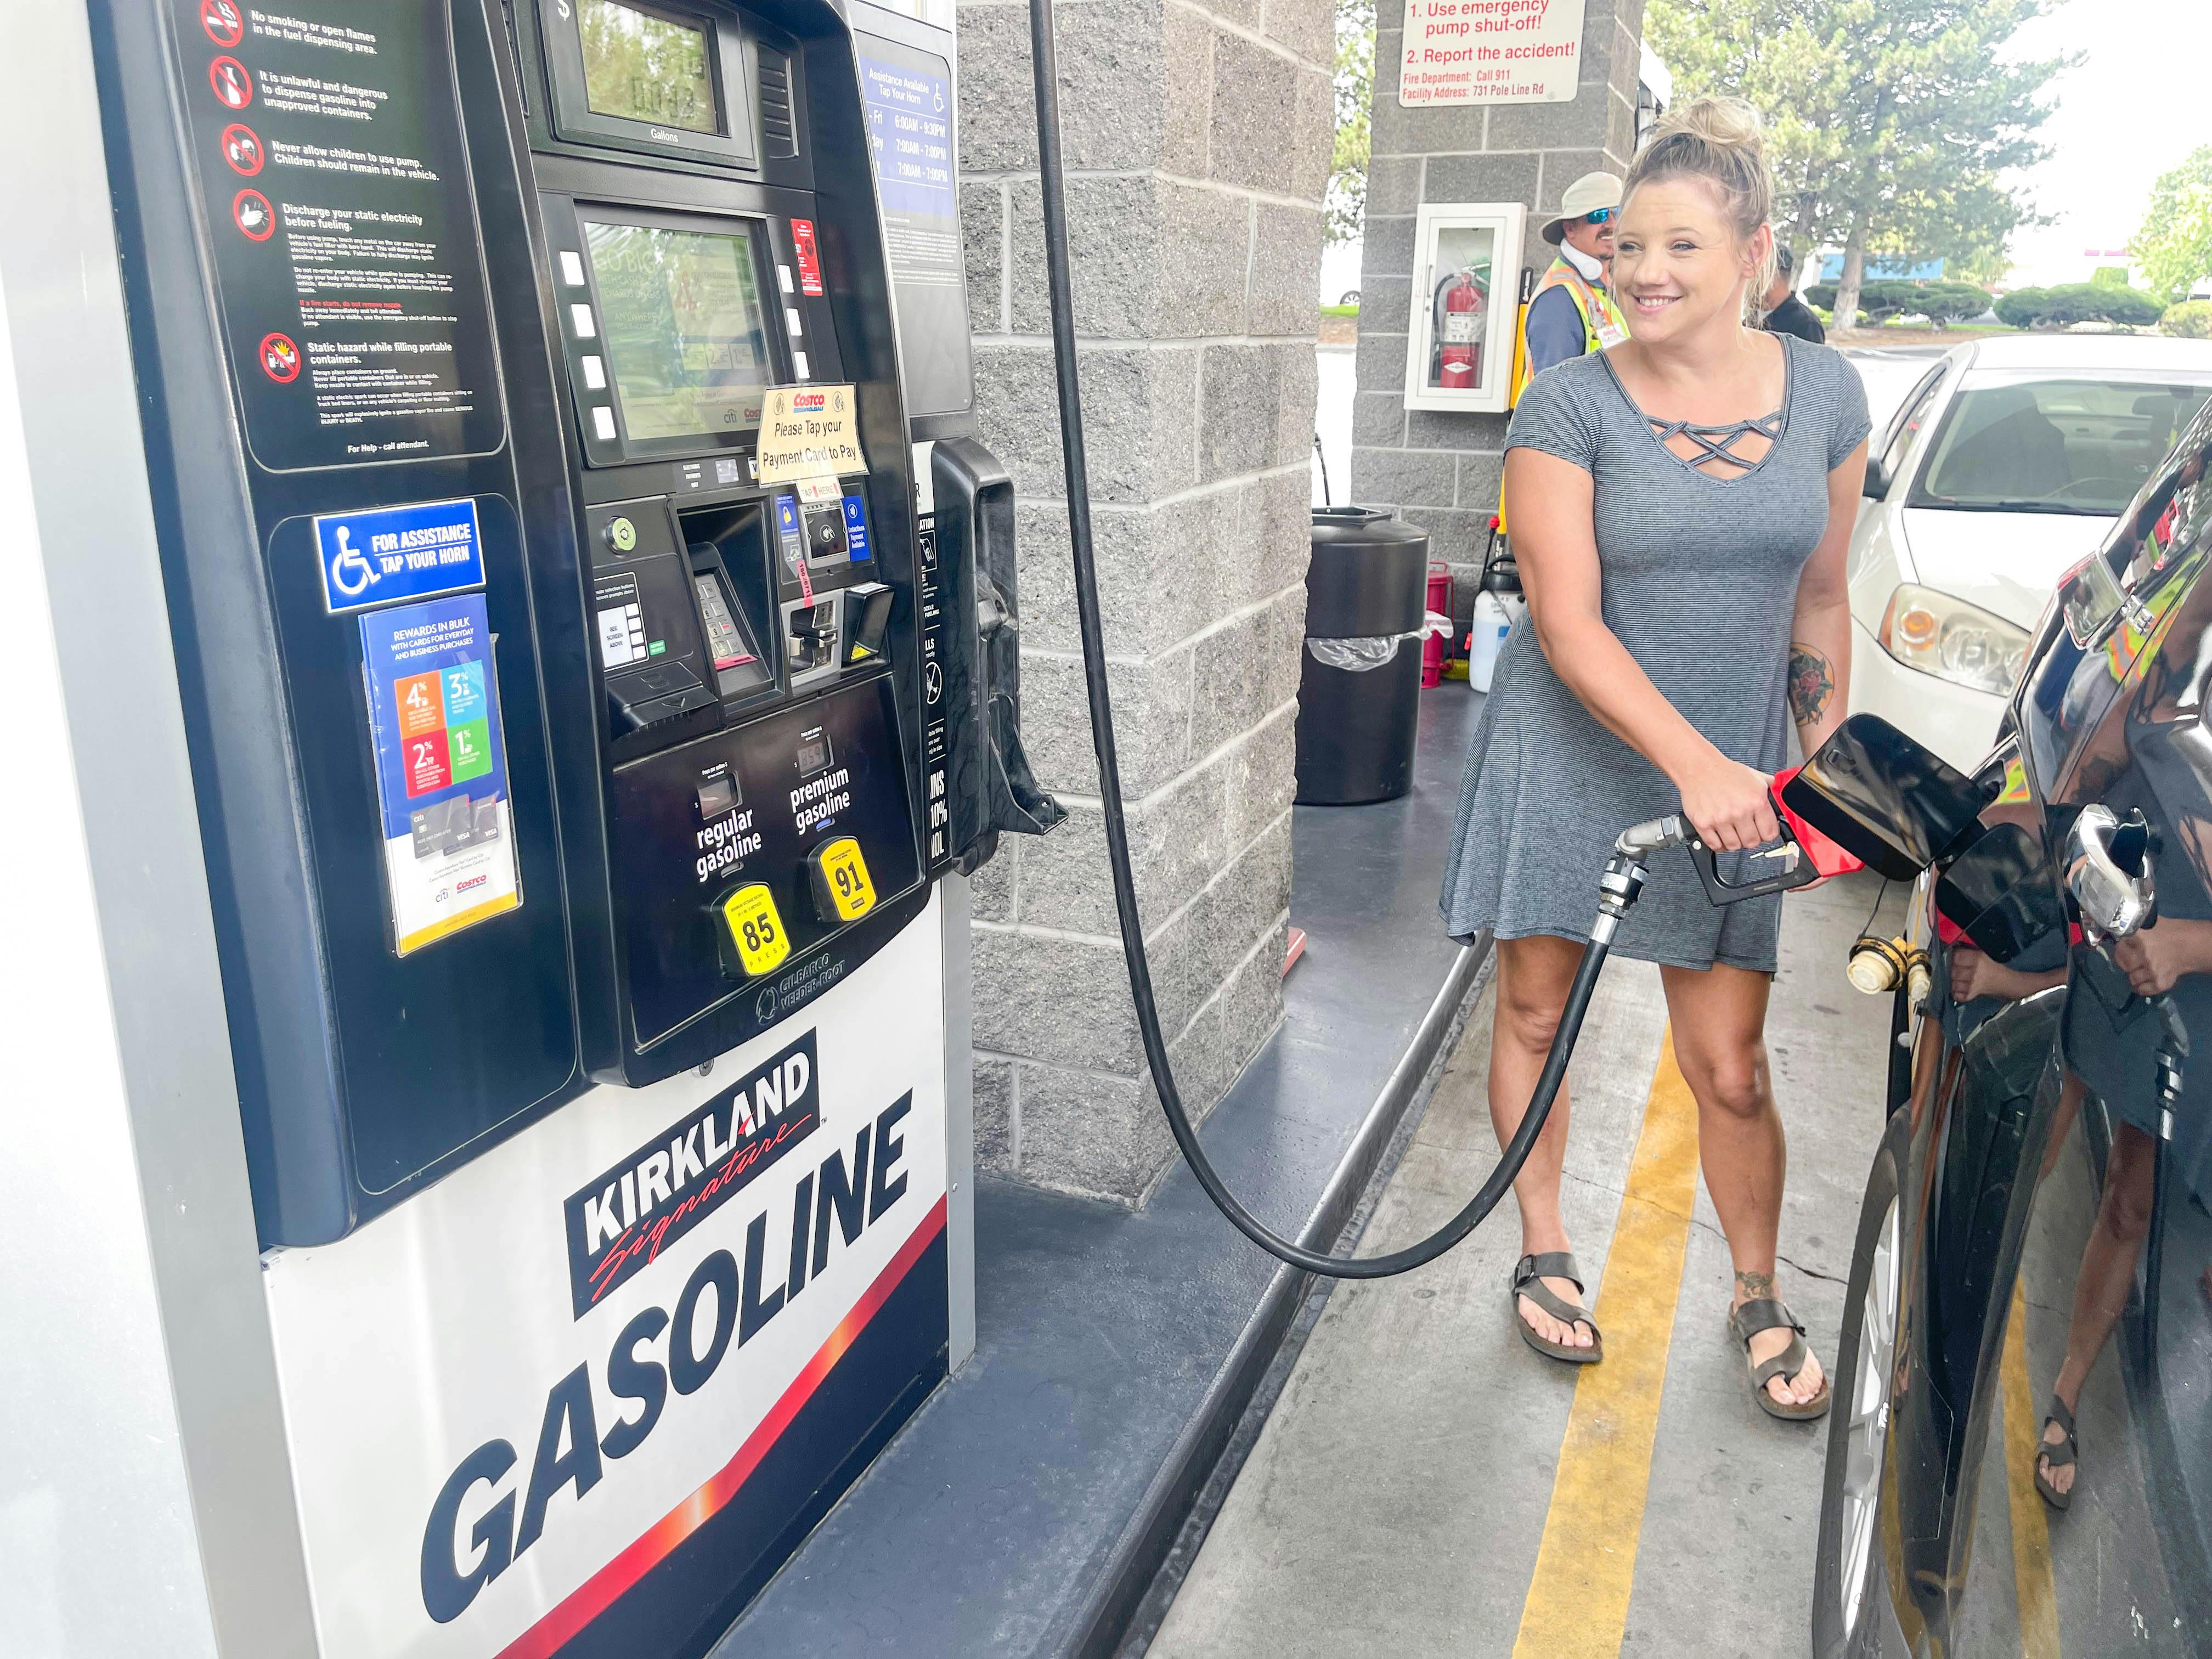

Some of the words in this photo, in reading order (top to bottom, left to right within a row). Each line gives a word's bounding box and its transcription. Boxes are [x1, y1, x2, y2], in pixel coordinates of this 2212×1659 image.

[1410, 4, 1421, 17] 1.
[1427, 2, 1456, 16] Use
[1462, 0, 1549, 16] emergency
[251, 10, 266, 22] No
[268, 15, 307, 31] smoking
[322, 25, 344, 37] open
[346, 28, 376, 42] flames
[1426, 22, 1469, 38] pump
[1475, 15, 1542, 33] shut-off!
[253, 24, 262, 33] in
[265, 25, 281, 37] the
[283, 29, 302, 41] fuel
[304, 33, 353, 52] dispensing
[355, 44, 377, 55] area.
[1407, 50, 1419, 63] 2.
[1424, 48, 1472, 65] Report
[1477, 46, 1500, 60] the
[1505, 42, 1575, 59] accident!
[259, 70, 268, 81] It
[270, 72, 278, 82] is
[281, 76, 320, 89] unlawful
[323, 83, 340, 92] and
[342, 84, 388, 100] dangerous
[869, 68, 902, 87] Assistance
[904, 78, 929, 94] Available
[1404, 72, 1419, 84] Fire
[1422, 71, 1471, 85] Department:
[1477, 70, 1493, 81] Call
[1496, 70, 1510, 81] 911
[262, 83, 273, 94] to
[275, 86, 317, 100] dispense
[319, 94, 357, 106] gasoline
[359, 100, 376, 109] into
[879, 84, 890, 98] Tap
[891, 87, 905, 100] Your
[906, 92, 921, 104] Horn
[1403, 87, 1431, 100] Facility
[1434, 87, 1469, 99] Address:
[1473, 85, 1487, 97] 731
[1491, 84, 1509, 96] Pole
[1511, 84, 1529, 95] Line
[1533, 83, 1544, 94] Rd
[264, 98, 320, 112] unapproved
[323, 106, 373, 120] containers.
[651, 128, 679, 143] Gallons
[874, 109, 883, 124] Fri
[895, 115, 918, 132] 6:00AM
[924, 121, 945, 138] 9:30PM
[272, 140, 301, 154] Never
[303, 145, 328, 156] allow
[329, 148, 366, 161] children
[368, 154, 377, 162] to
[379, 156, 394, 164] use
[396, 157, 422, 168] pump.
[896, 139, 919, 155] 7:00AM
[925, 145, 946, 160] 7:00PM
[274, 154, 314, 167] Children
[318, 158, 348, 170] should
[350, 164, 380, 174] remain
[382, 166, 391, 176] in
[393, 167, 406, 177] the
[408, 170, 439, 180] vehicle.
[898, 162, 921, 178] 7:00AM
[926, 167, 948, 182] 7:00PM
[282, 203, 330, 218] Discharge
[332, 209, 352, 219] your
[354, 211, 379, 221] static
[381, 212, 422, 226] electricity
[285, 216, 316, 228] before
[318, 219, 352, 232] fueling.
[307, 342, 335, 352] Static
[337, 342, 368, 352] hazard
[370, 342, 393, 351] while
[394, 342, 417, 353] filling
[420, 342, 452, 353] portable
[311, 355, 362, 364] containers.
[794, 393, 825, 407] COSTCO
[724, 409, 737, 424] citi
[744, 408, 761, 418] COST
[775, 422, 802, 437] Please
[805, 420, 820, 437] Tap
[823, 421, 842, 437] your
[348, 445, 360, 453] For
[361, 444, 377, 453] Help
[397, 440, 429, 449] attendant.
[763, 449, 804, 469] Payment
[805, 447, 827, 461] Card
[829, 447, 838, 459] to
[839, 445, 856, 460] Pay
[801, 489, 812, 497] TAP
[819, 486, 834, 494] HERE
[919, 517, 934, 531] ATION
[372, 533, 398, 552] FOR
[400, 523, 471, 548] ASSISTANCE
[380, 555, 404, 574] TAP
[406, 549, 437, 569] YOUR
[438, 545, 470, 565] HORN
[391, 642, 408, 651] WITH
[409, 637, 431, 647] CARDS
[431, 635, 444, 643] FOR
[444, 628, 474, 640] EVERYDAY
[393, 623, 437, 641] REWARDS
[438, 622, 448, 631] IN
[449, 617, 470, 630] BULK
[395, 651, 409, 660] AND
[410, 645, 439, 657] BUSINESS
[439, 637, 473, 651] PURCHASES
[407, 681, 426, 708] 4%
[449, 672, 469, 698] 3%
[455, 729, 471, 754] 1%
[413, 741, 433, 769] 2%
[790, 769, 849, 813] premium
[414, 812, 424, 822] citi
[796, 791, 850, 835] gasoline
[930, 799, 947, 829] 10%
[457, 832, 470, 840] VISA
[484, 828, 496, 837] VISA
[697, 809, 752, 849] regular
[697, 832, 761, 882] gasoline
[456, 874, 486, 890] COSTCO
[836, 861, 864, 897] 91
[436, 888, 448, 902] citi
[743, 912, 775, 951] 85
[749, 943, 785, 967] PRESS
[780, 953, 830, 994] GILBARCO
[781, 960, 845, 1009] VEEDER-ROOT
[584, 1052, 810, 1256] KIRKLAND
[589, 1114, 812, 1302] Signature
[421, 1087, 913, 1623] GASOLINE
